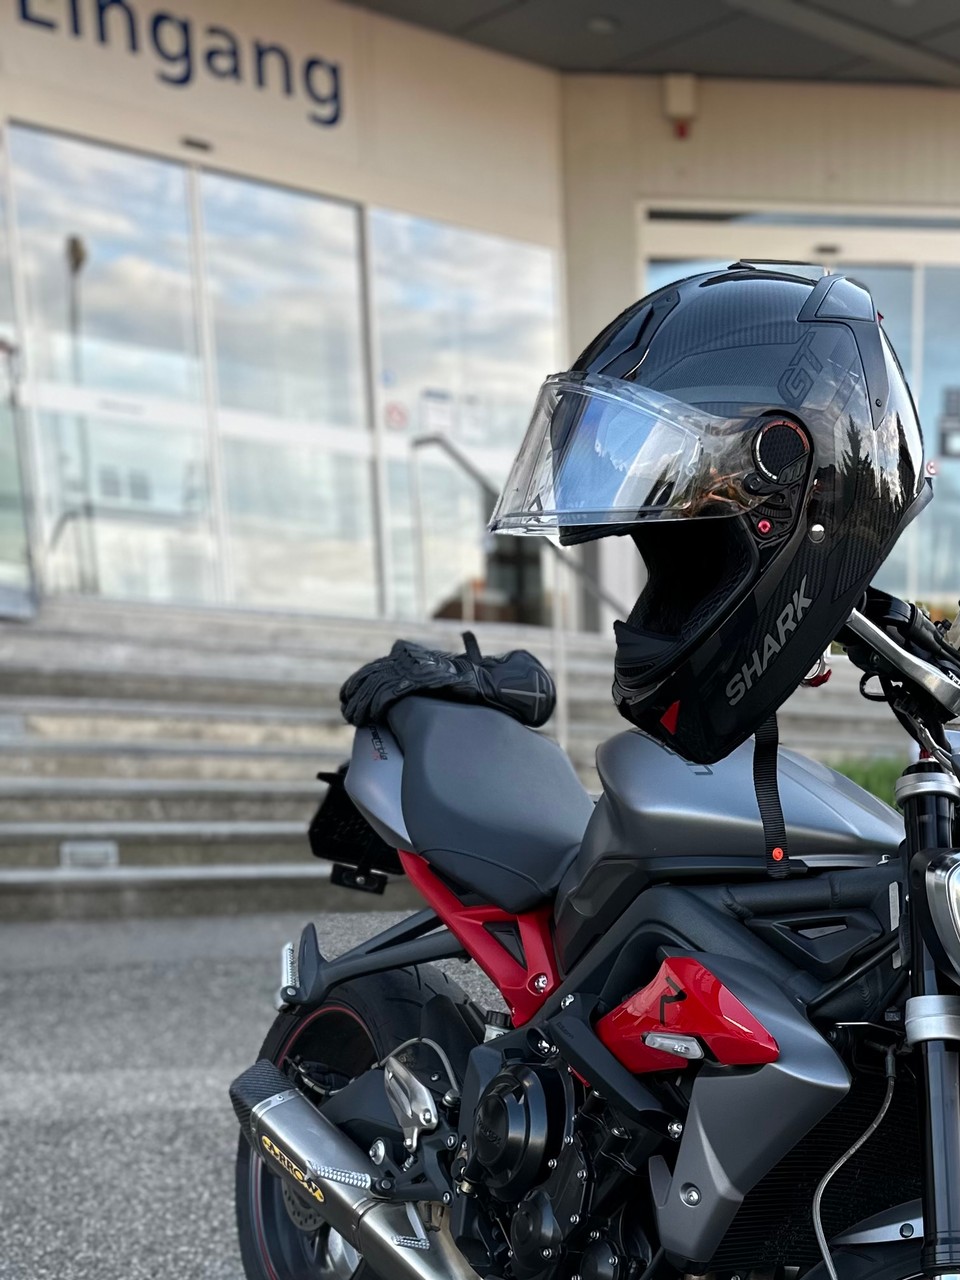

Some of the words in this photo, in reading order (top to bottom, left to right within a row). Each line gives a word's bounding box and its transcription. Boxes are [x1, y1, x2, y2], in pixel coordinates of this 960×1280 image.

[17, 0, 343, 126] ingang
[777, 331, 824, 408] GT
[725, 574, 813, 706] SHARK
